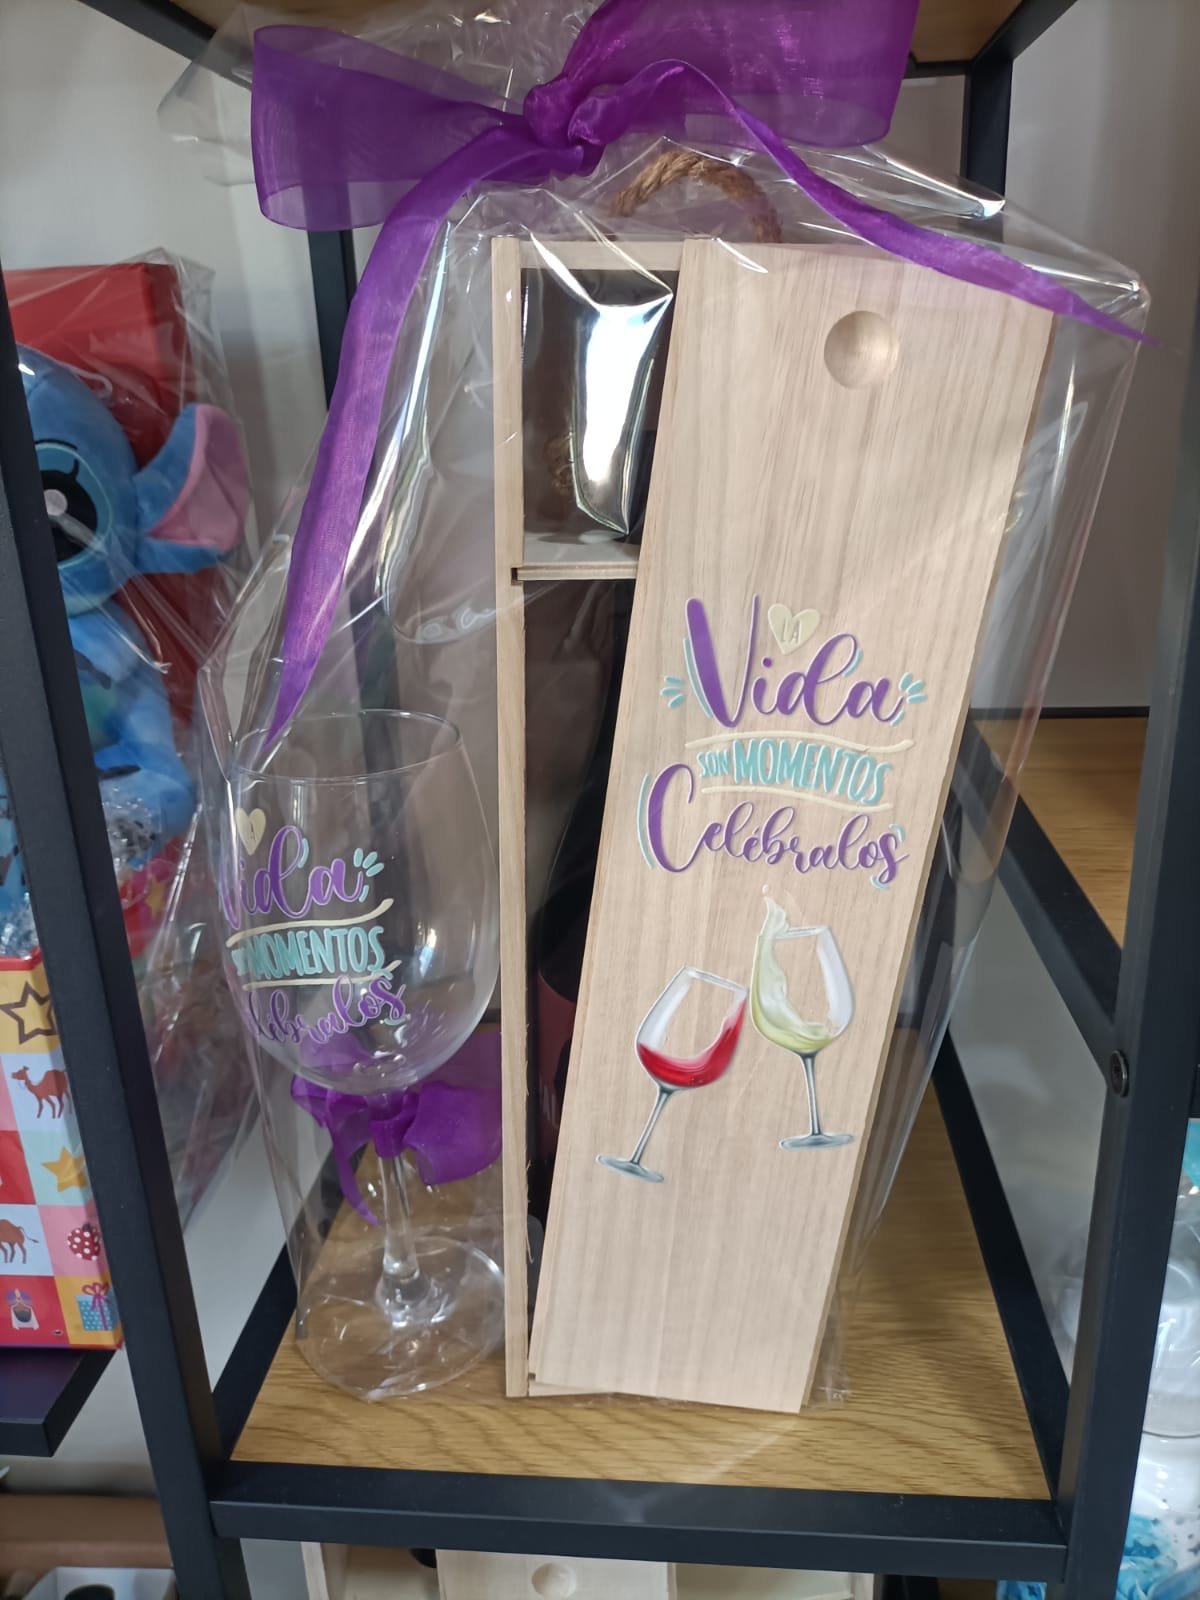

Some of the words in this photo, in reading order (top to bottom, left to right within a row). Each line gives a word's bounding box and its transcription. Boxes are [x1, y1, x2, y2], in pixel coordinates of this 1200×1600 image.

[686, 593, 906, 728] Vida
[696, 748, 731, 778] SON
[732, 738, 894, 805] MOMENTOS
